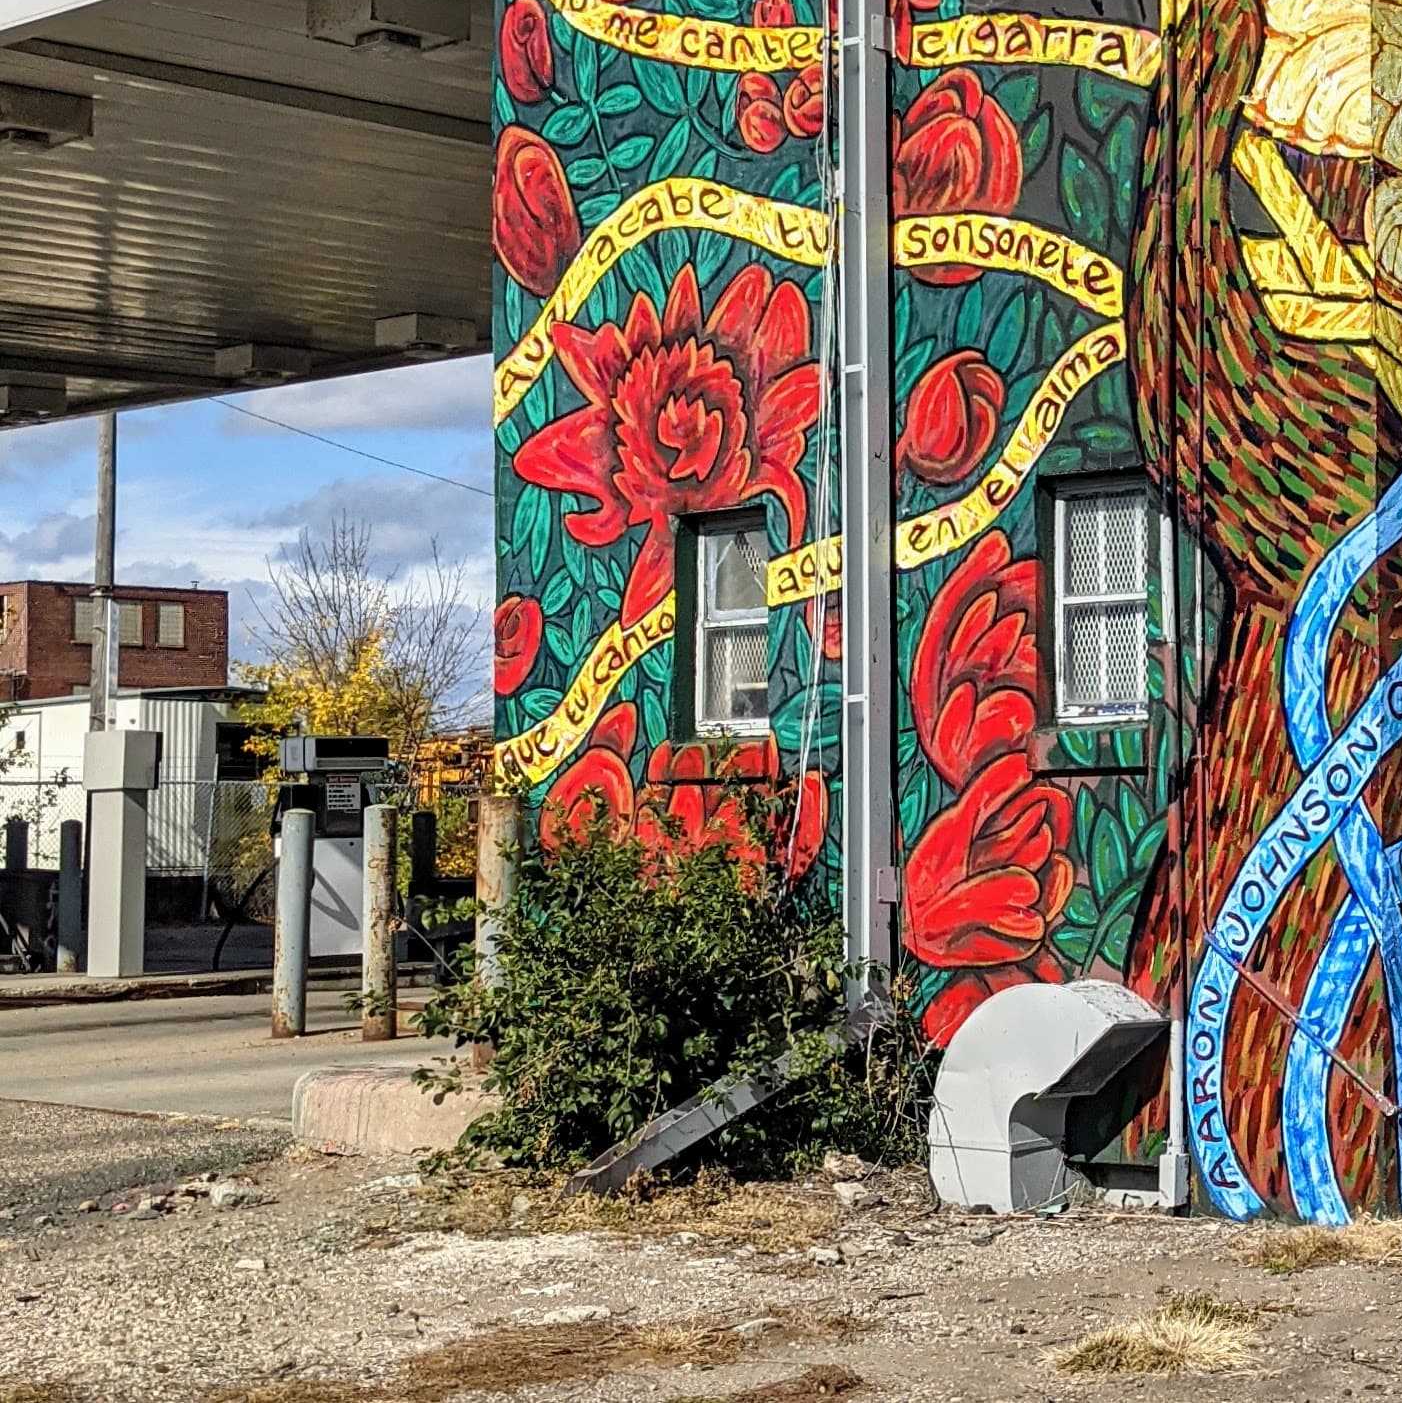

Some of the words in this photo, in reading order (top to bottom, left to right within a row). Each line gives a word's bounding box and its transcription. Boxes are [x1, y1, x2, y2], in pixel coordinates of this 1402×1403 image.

[609, 13, 659, 45] me
[917, 20, 1128, 69] cigarra
[590, 183, 733, 265] acabe
[778, 212, 829, 254] tu
[907, 221, 1115, 295] sonsonete
[567, 690, 592, 725] tu
[594, 614, 675, 684] canto
[777, 544, 843, 594] aqu
[908, 514, 958, 553] en
[986, 459, 1025, 507] el
[1035, 334, 1121, 434] alma
[1191, 983, 1242, 1192] AARON
